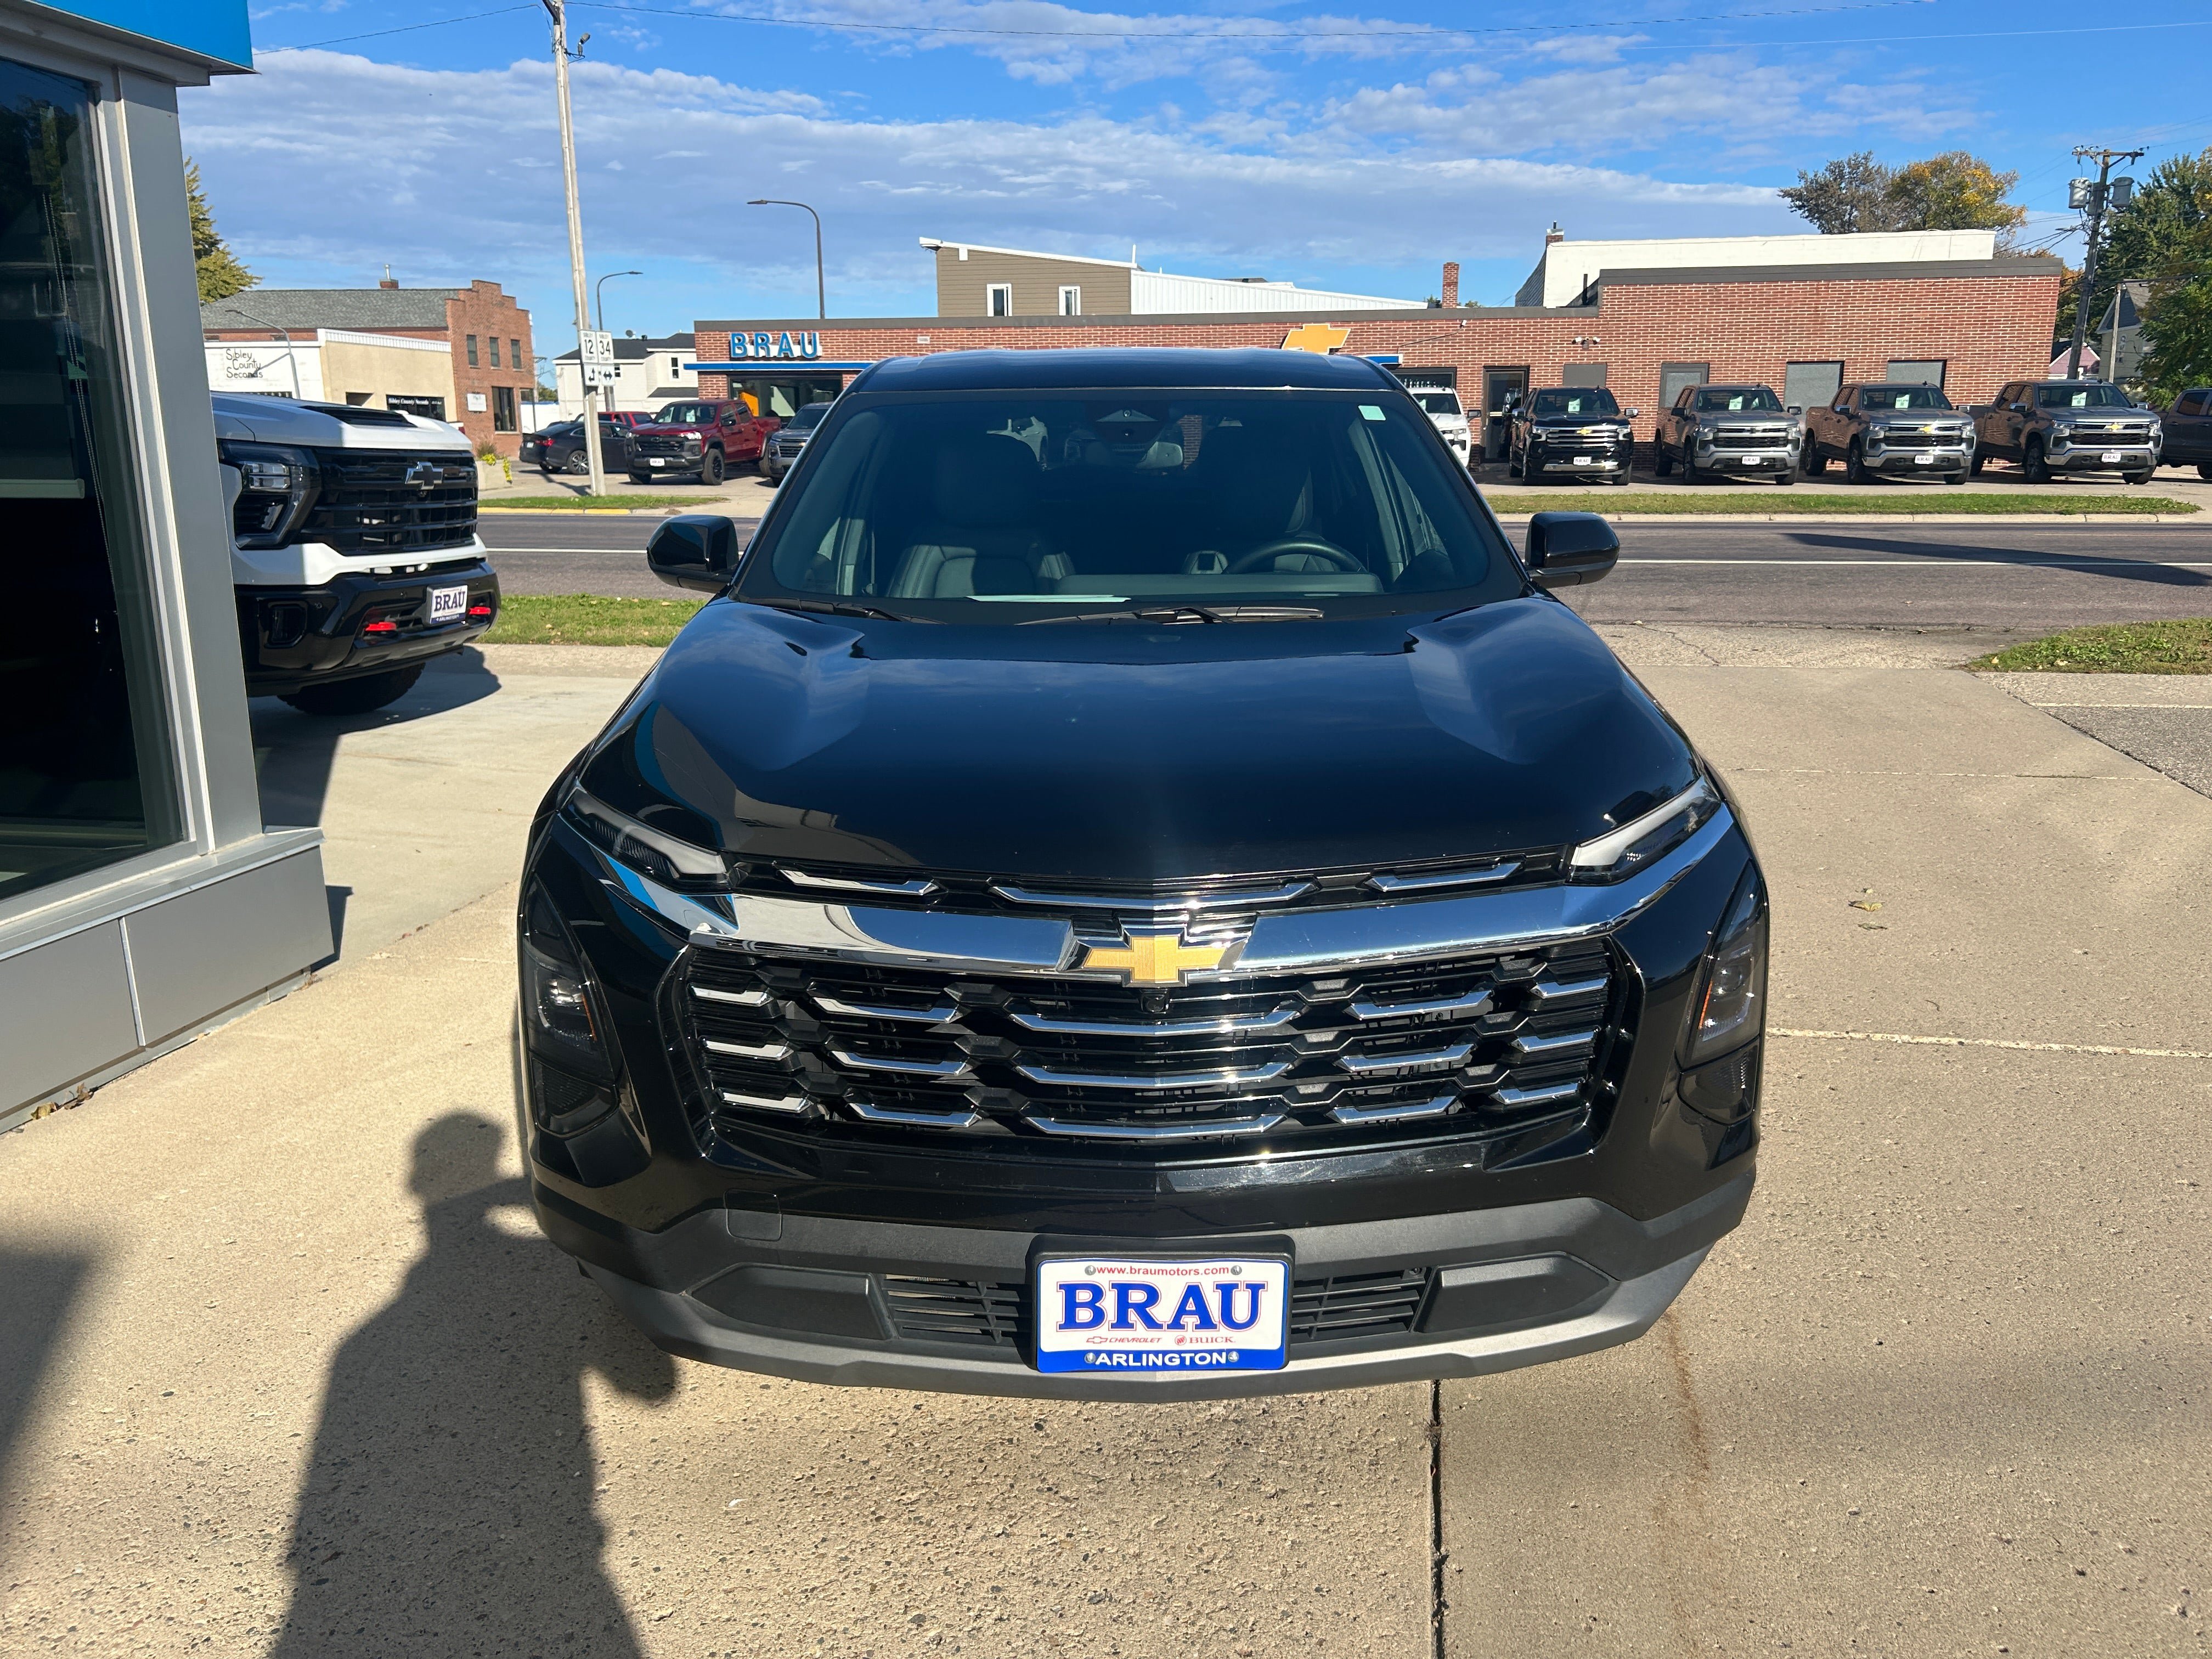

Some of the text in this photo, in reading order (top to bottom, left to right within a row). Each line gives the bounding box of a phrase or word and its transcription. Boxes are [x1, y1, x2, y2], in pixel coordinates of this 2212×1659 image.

[584, 339, 594, 354] 12
[599, 340, 611, 355] 34
[731, 332, 820, 358] BRAU
[226, 348, 252, 362] Sibley
[233, 358, 261, 370] County
[434, 591, 465, 612] BRAU
[1097, 1266, 1229, 1276] www.braumotors.com
[1057, 1280, 1268, 1332] BRAU
[1096, 1352, 1226, 1367] ARLINGTON
